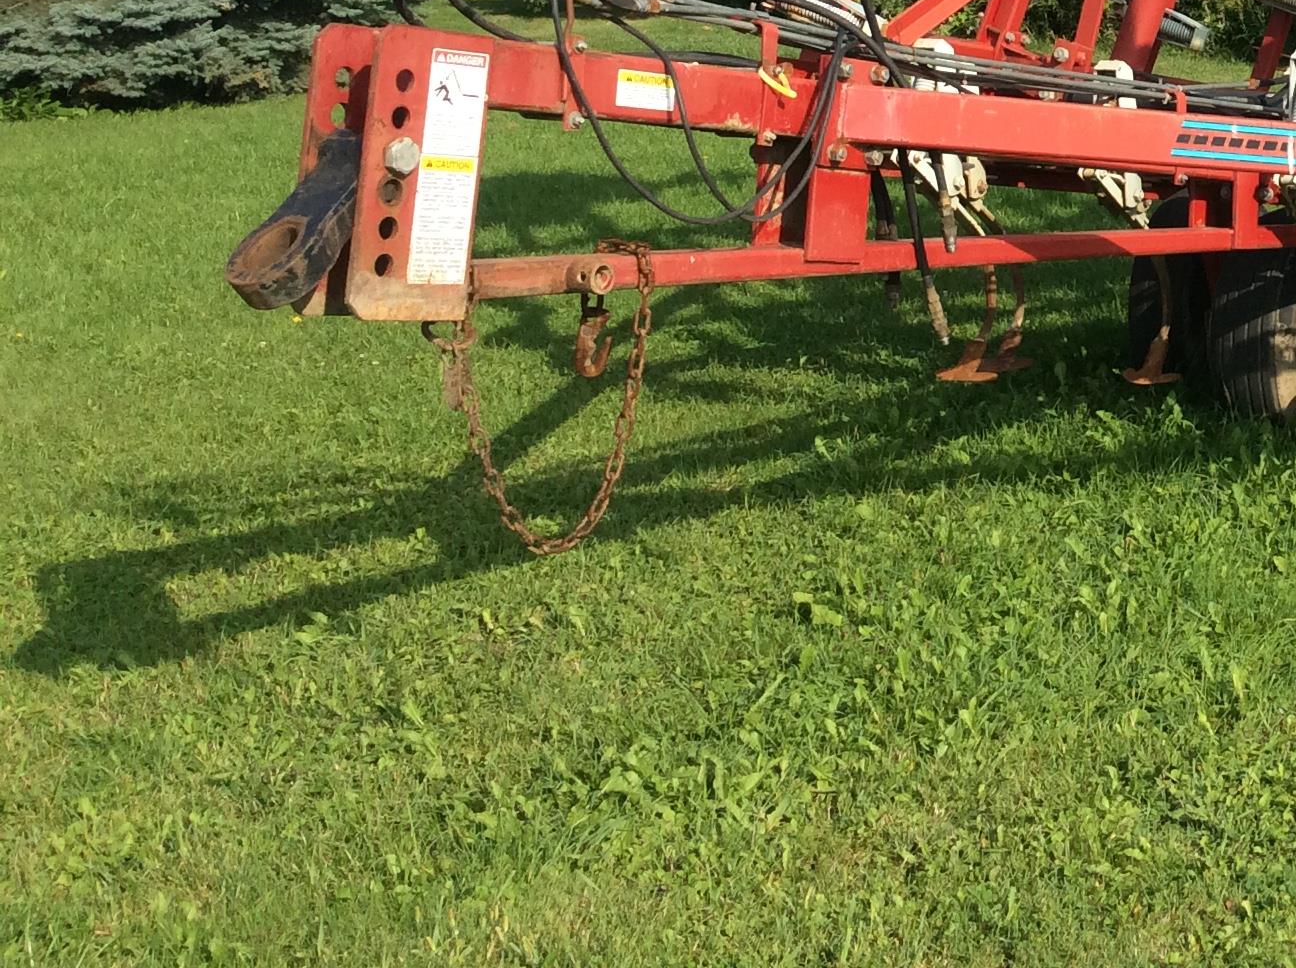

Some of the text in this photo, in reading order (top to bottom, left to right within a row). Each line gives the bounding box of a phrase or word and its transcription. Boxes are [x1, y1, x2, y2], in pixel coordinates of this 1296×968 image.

[446, 53, 485, 66] DANGER
[634, 74, 670, 86] CAUTION
[435, 159, 471, 170] CAUTION
